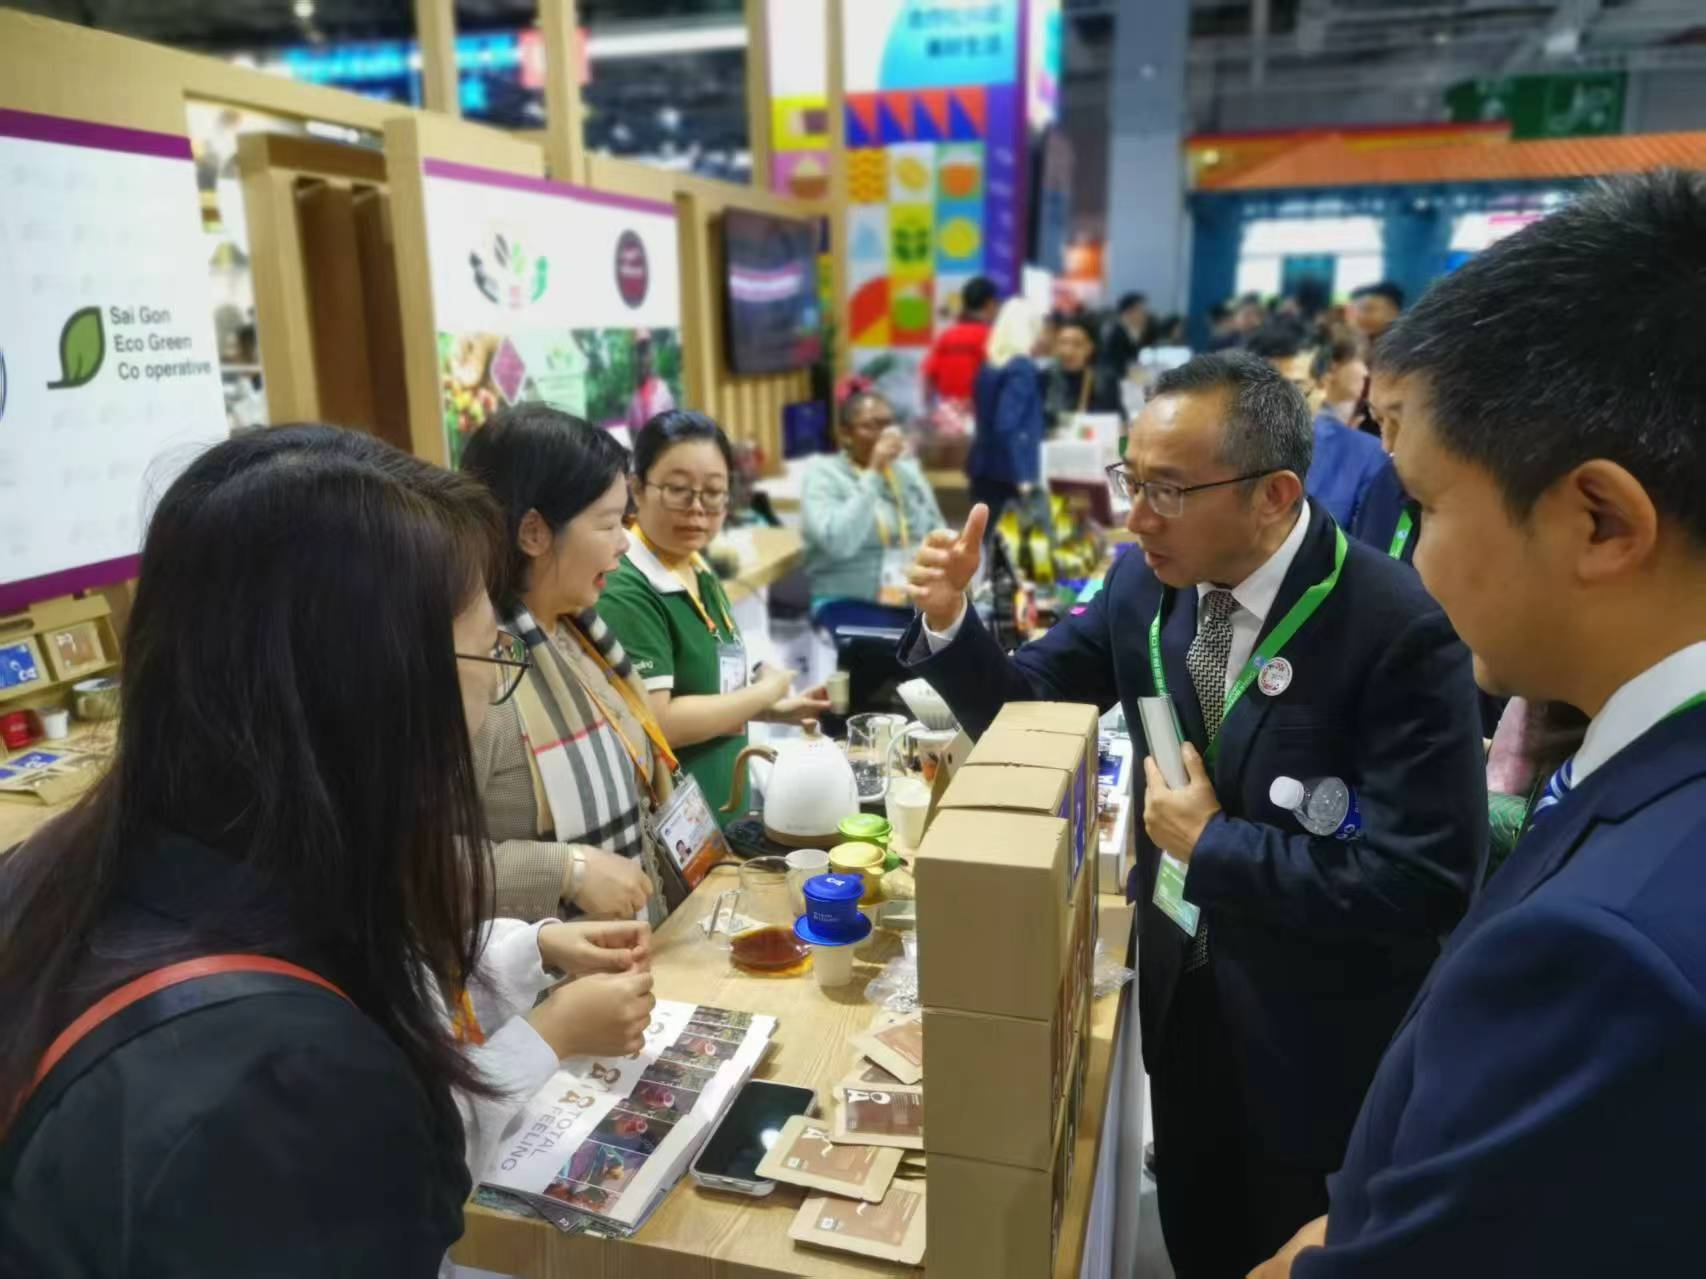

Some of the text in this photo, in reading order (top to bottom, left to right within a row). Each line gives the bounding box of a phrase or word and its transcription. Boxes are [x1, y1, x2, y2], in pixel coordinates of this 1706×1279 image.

[110, 306, 171, 325] Sai Gon
[114, 333, 193, 353] Eco Green
[118, 358, 212, 381] Co operative
[501, 1106, 563, 1171] FEELING
[529, 1109, 583, 1159] TOTAL
